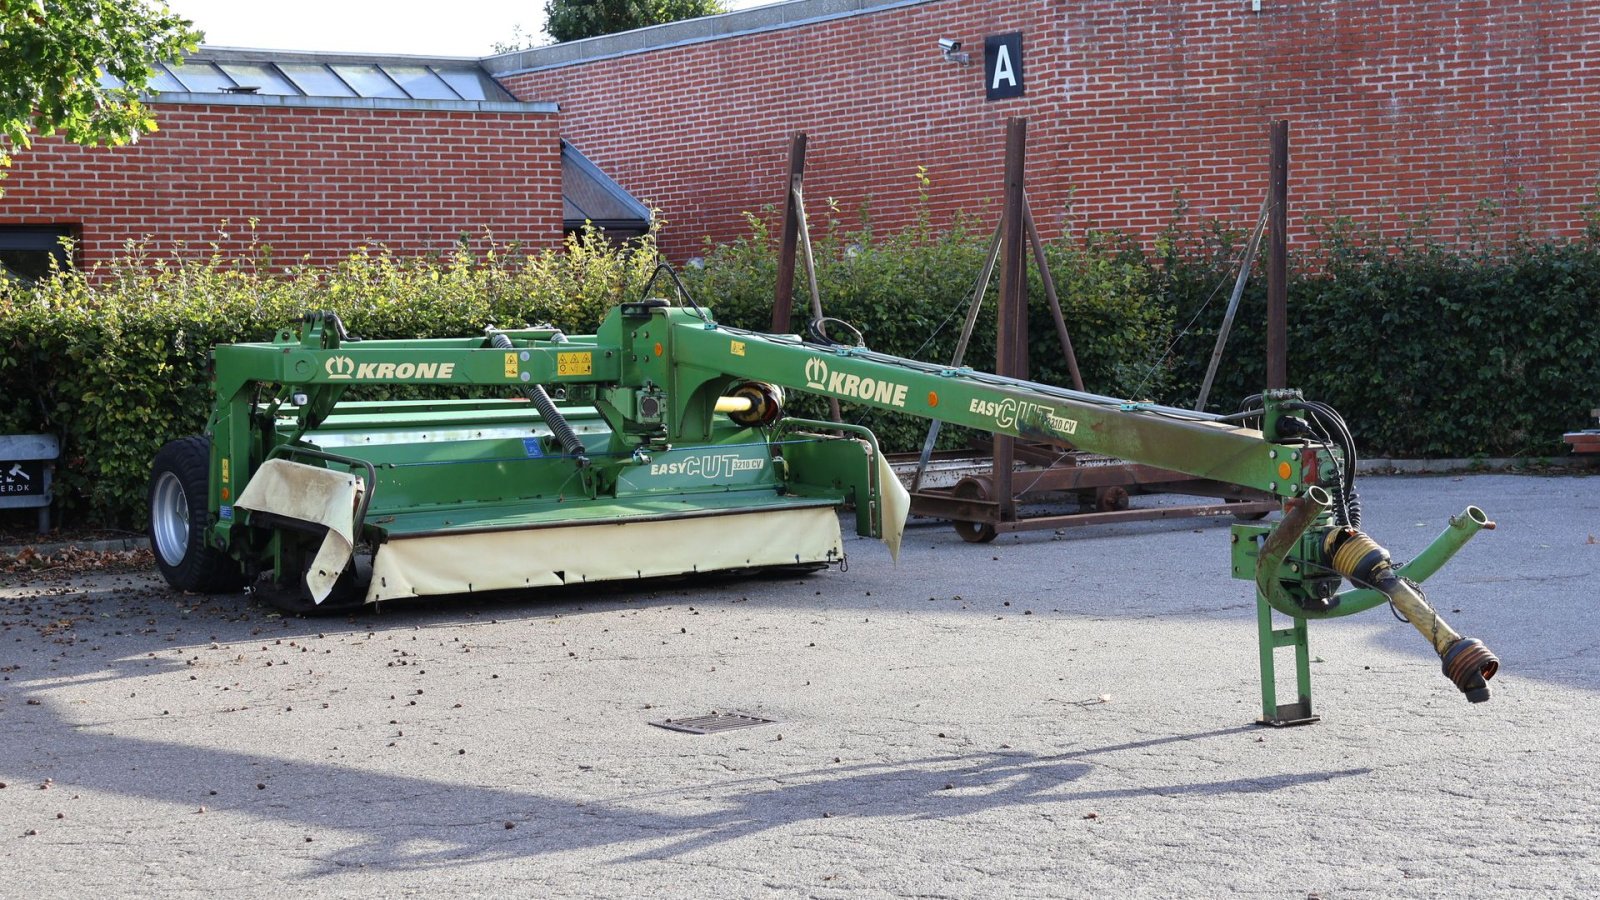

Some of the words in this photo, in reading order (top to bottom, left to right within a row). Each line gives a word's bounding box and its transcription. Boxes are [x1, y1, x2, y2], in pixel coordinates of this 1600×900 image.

[992, 44, 1017, 89] A
[356, 362, 455, 379] KRONE
[828, 371, 909, 408] KRONE
[751, 460, 762, 469] CV
